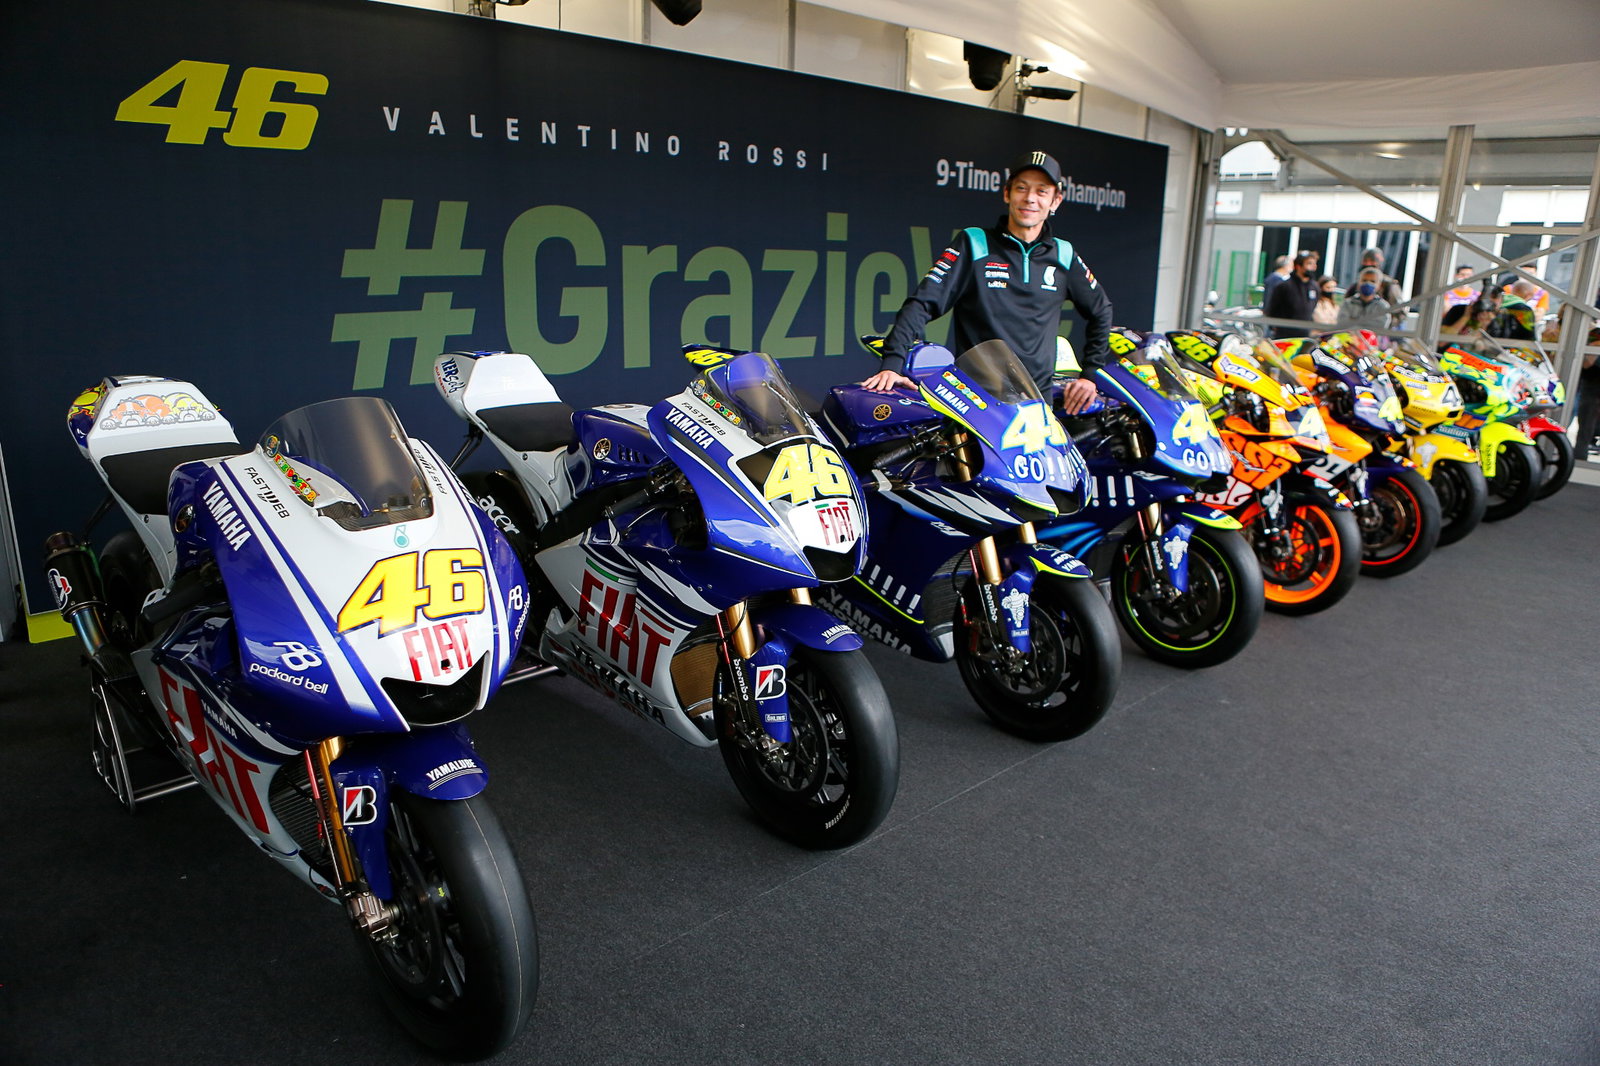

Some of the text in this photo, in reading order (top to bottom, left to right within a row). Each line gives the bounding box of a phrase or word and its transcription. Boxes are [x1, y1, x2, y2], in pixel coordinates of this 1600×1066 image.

[115, 60, 329, 150] 46
[383, 106, 828, 172] VALENTINO ROSSI
[936, 158, 1001, 193] 9-Time
[685, 349, 734, 366] 46
[1173, 334, 1217, 362] 46
[934, 383, 970, 415] YAMAHA
[664, 407, 715, 450] YAMAHA
[243, 466, 290, 519] FASTWEB
[764, 443, 852, 506] 46
[202, 480, 252, 551] YAMAHA
[478, 495, 520, 535] acer
[817, 506, 855, 545] FIAT
[336, 547, 486, 639] 46
[984, 584, 997, 624] brembo
[577, 569, 671, 688] FIAT
[831, 588, 912, 655] YAMAHA
[402, 618, 473, 682] FIAT
[250, 662, 329, 695] packard bell
[733, 658, 749, 701] brembo
[201, 699, 238, 740] YAMAHA
[426, 758, 477, 782] YAMALUBE
